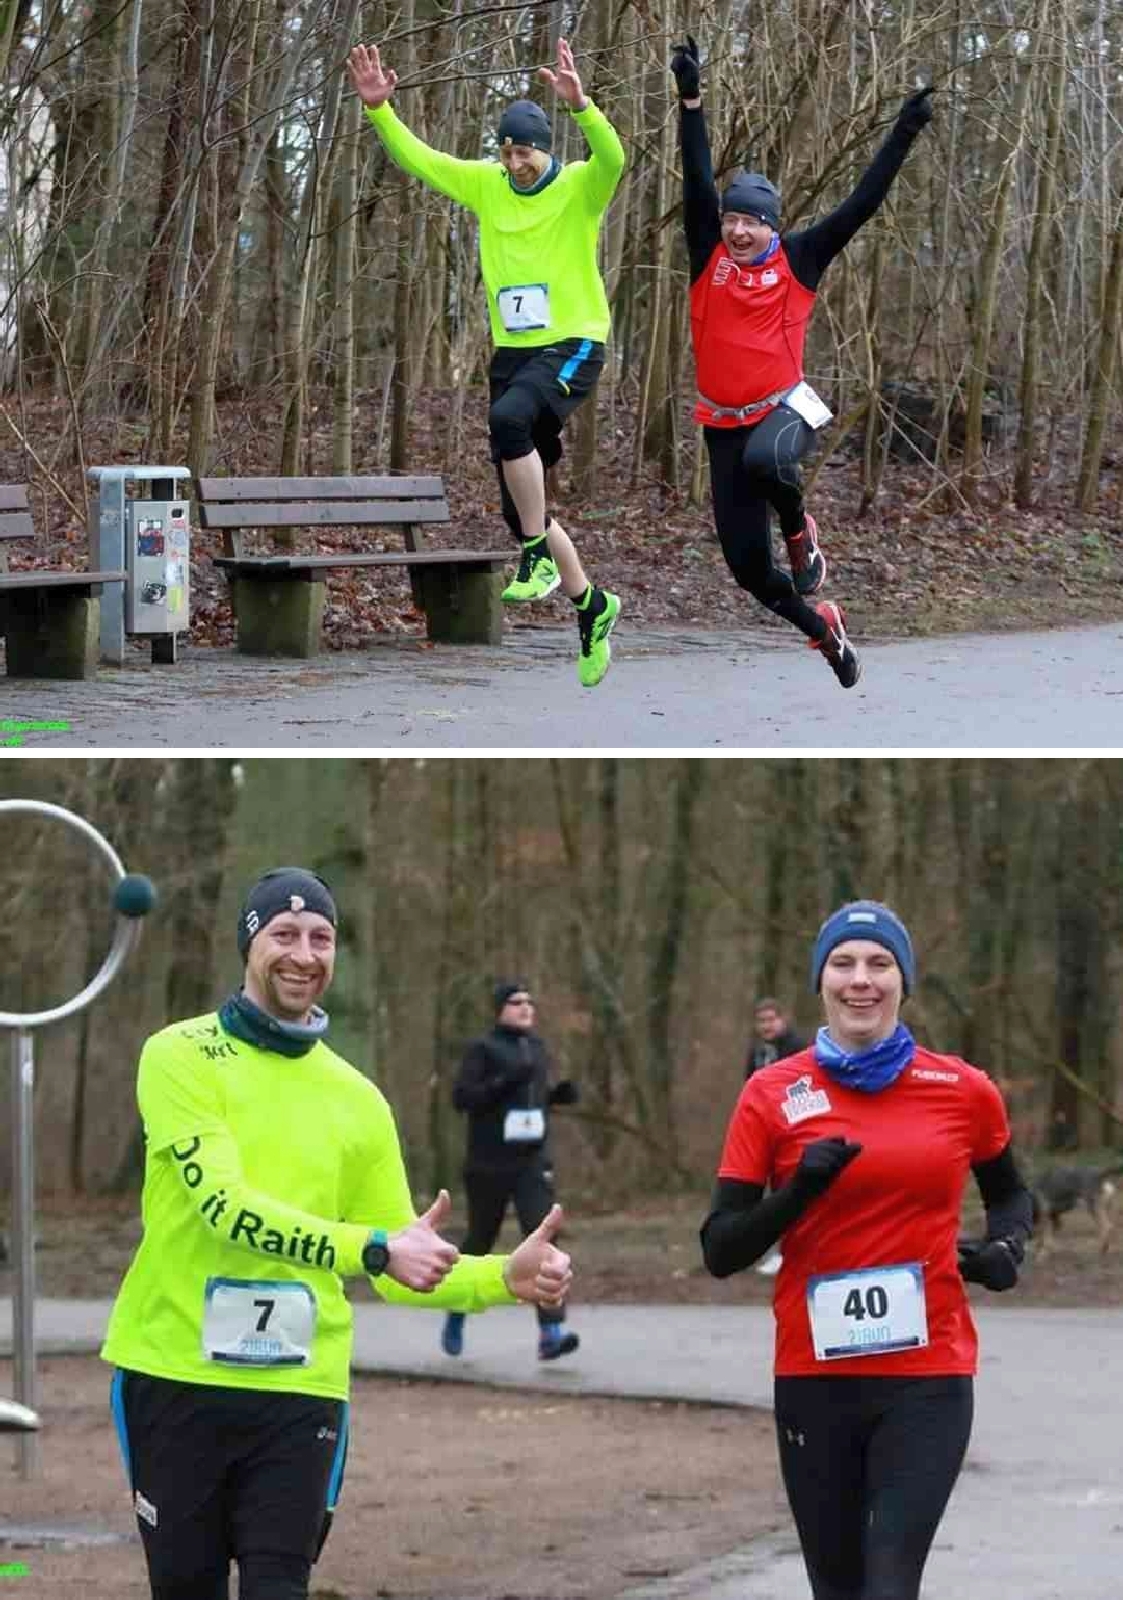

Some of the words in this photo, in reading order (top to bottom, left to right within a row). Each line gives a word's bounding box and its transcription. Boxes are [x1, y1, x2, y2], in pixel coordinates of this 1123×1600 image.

[513, 296, 523, 313] 7
[201, 1190, 227, 1227] it
[230, 1209, 335, 1269] Raith
[253, 1299, 275, 1332] 7
[843, 1286, 888, 1320] 40
